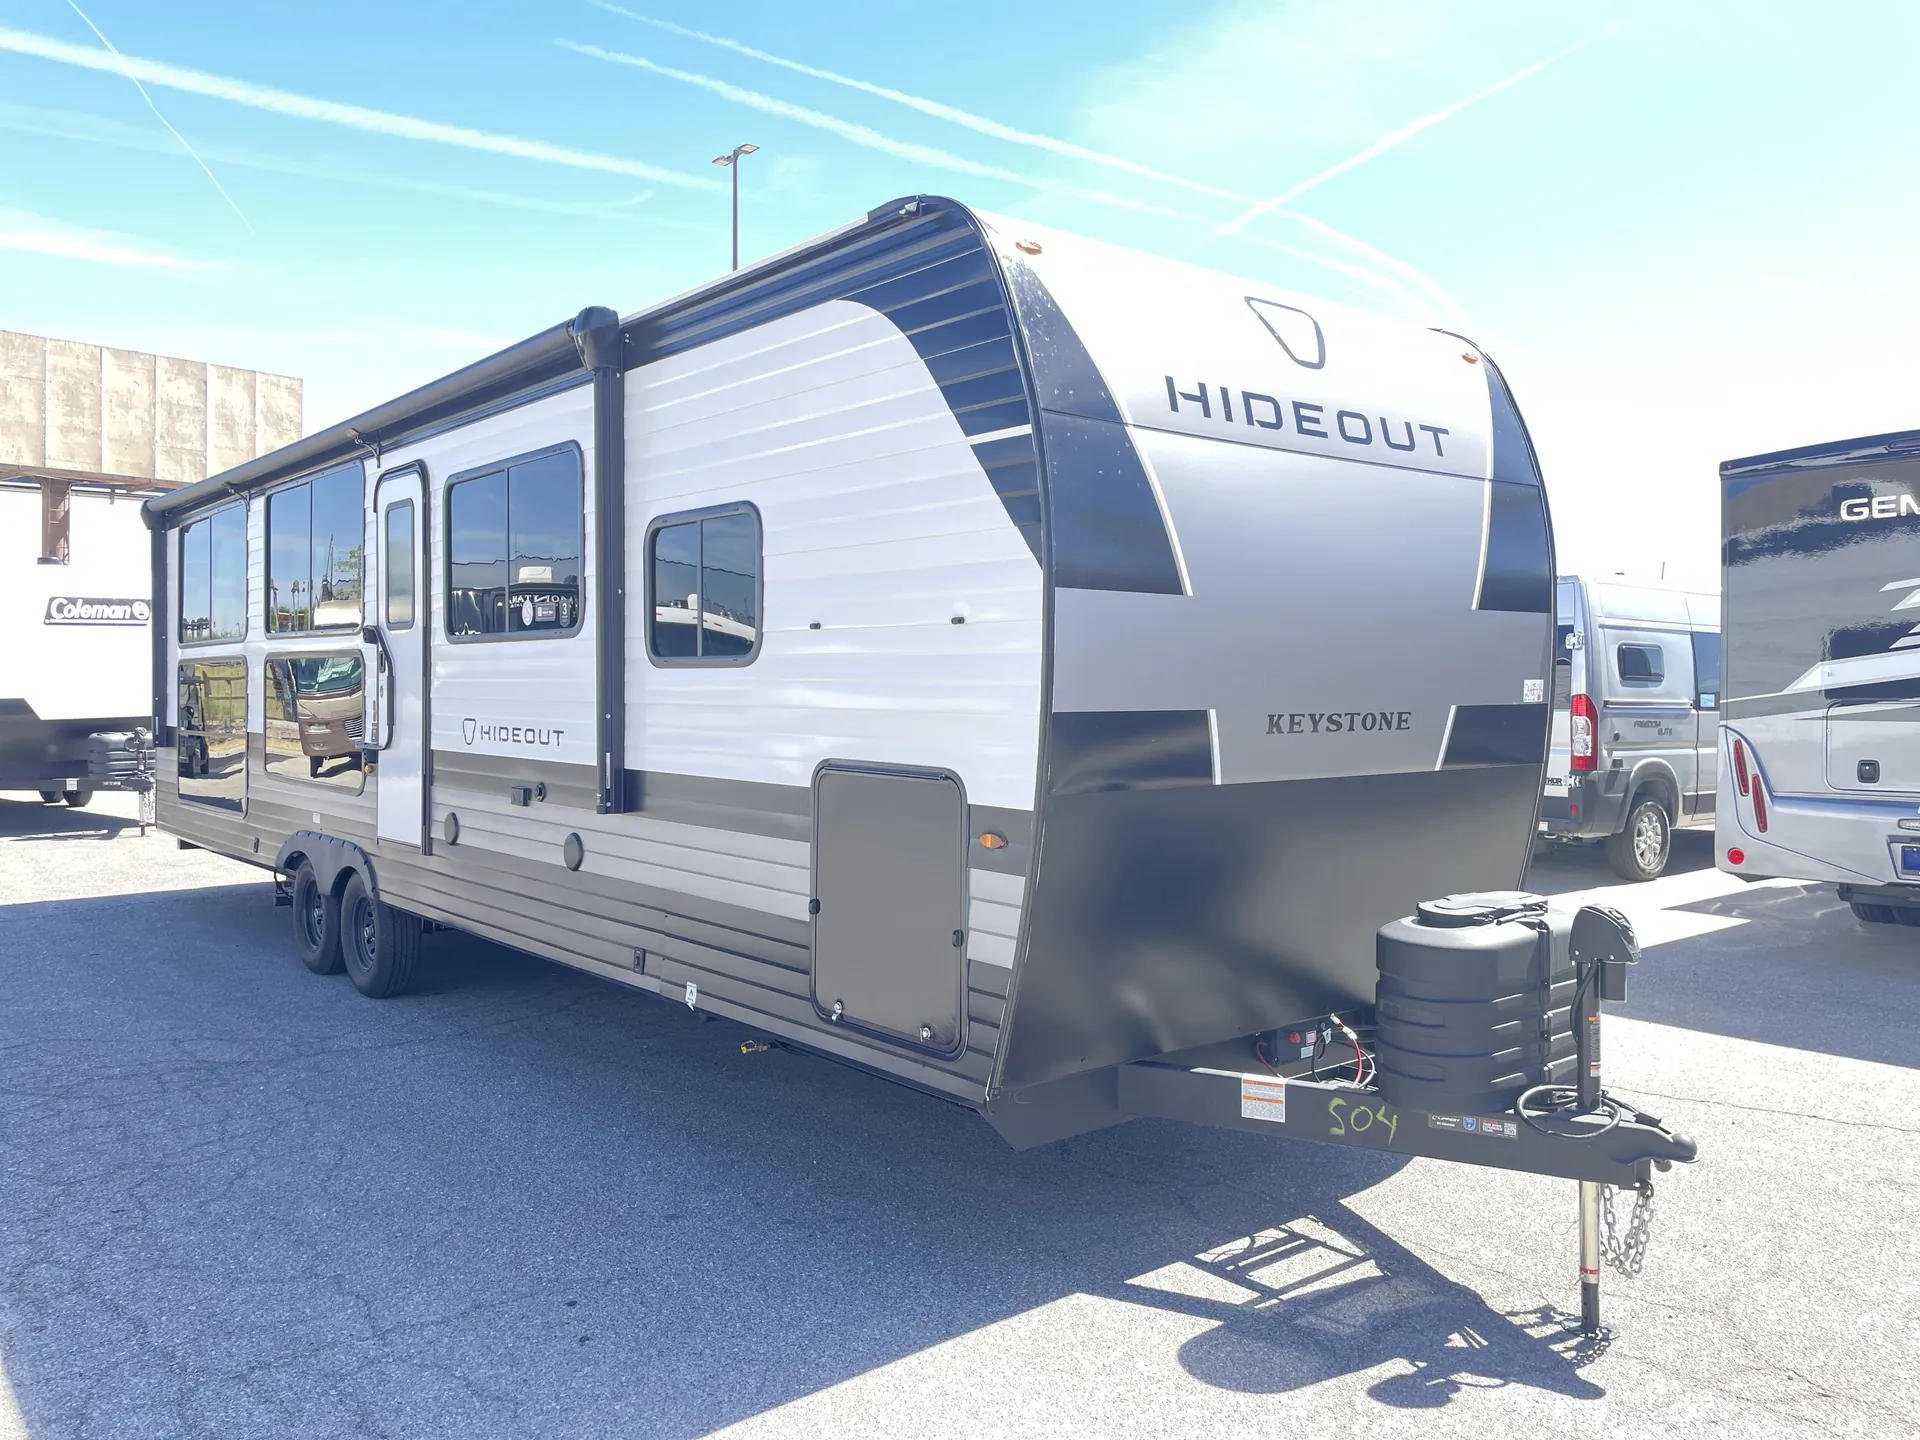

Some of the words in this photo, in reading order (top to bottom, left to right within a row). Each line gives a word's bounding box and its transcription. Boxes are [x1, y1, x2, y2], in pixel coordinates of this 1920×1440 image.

[1165, 376, 1449, 457] HIDEOUT
[50, 597, 132, 620] Coleman
[1266, 711, 1412, 735] KEYSTONE
[1633, 720, 1661, 728] FREEDOM
[480, 724, 564, 747] HIDEOUT
[1546, 777, 1563, 785] HOR
